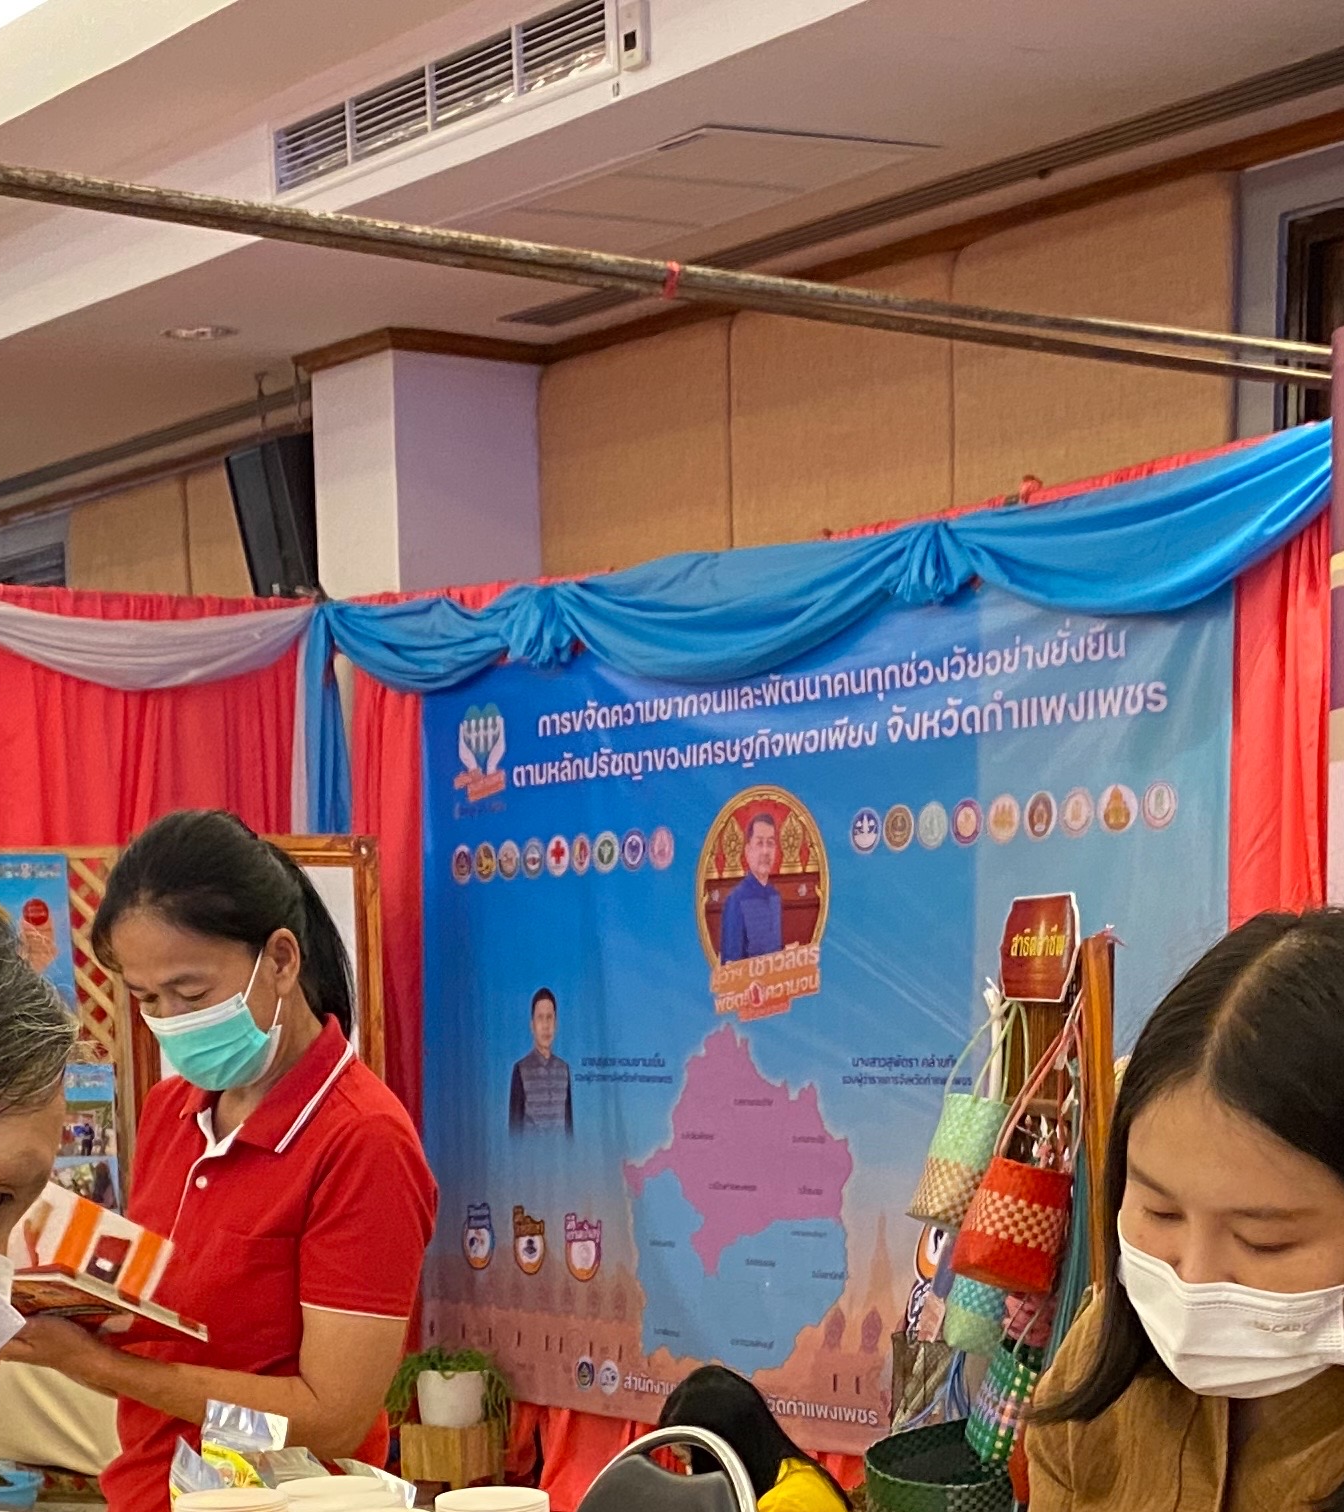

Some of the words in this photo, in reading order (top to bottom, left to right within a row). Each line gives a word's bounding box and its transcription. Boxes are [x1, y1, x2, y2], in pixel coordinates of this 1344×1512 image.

[886, 681, 1169, 744] จังหวัดกำแพงเพชร
[764, 1393, 880, 1426] วัดกำแพงเพชร
